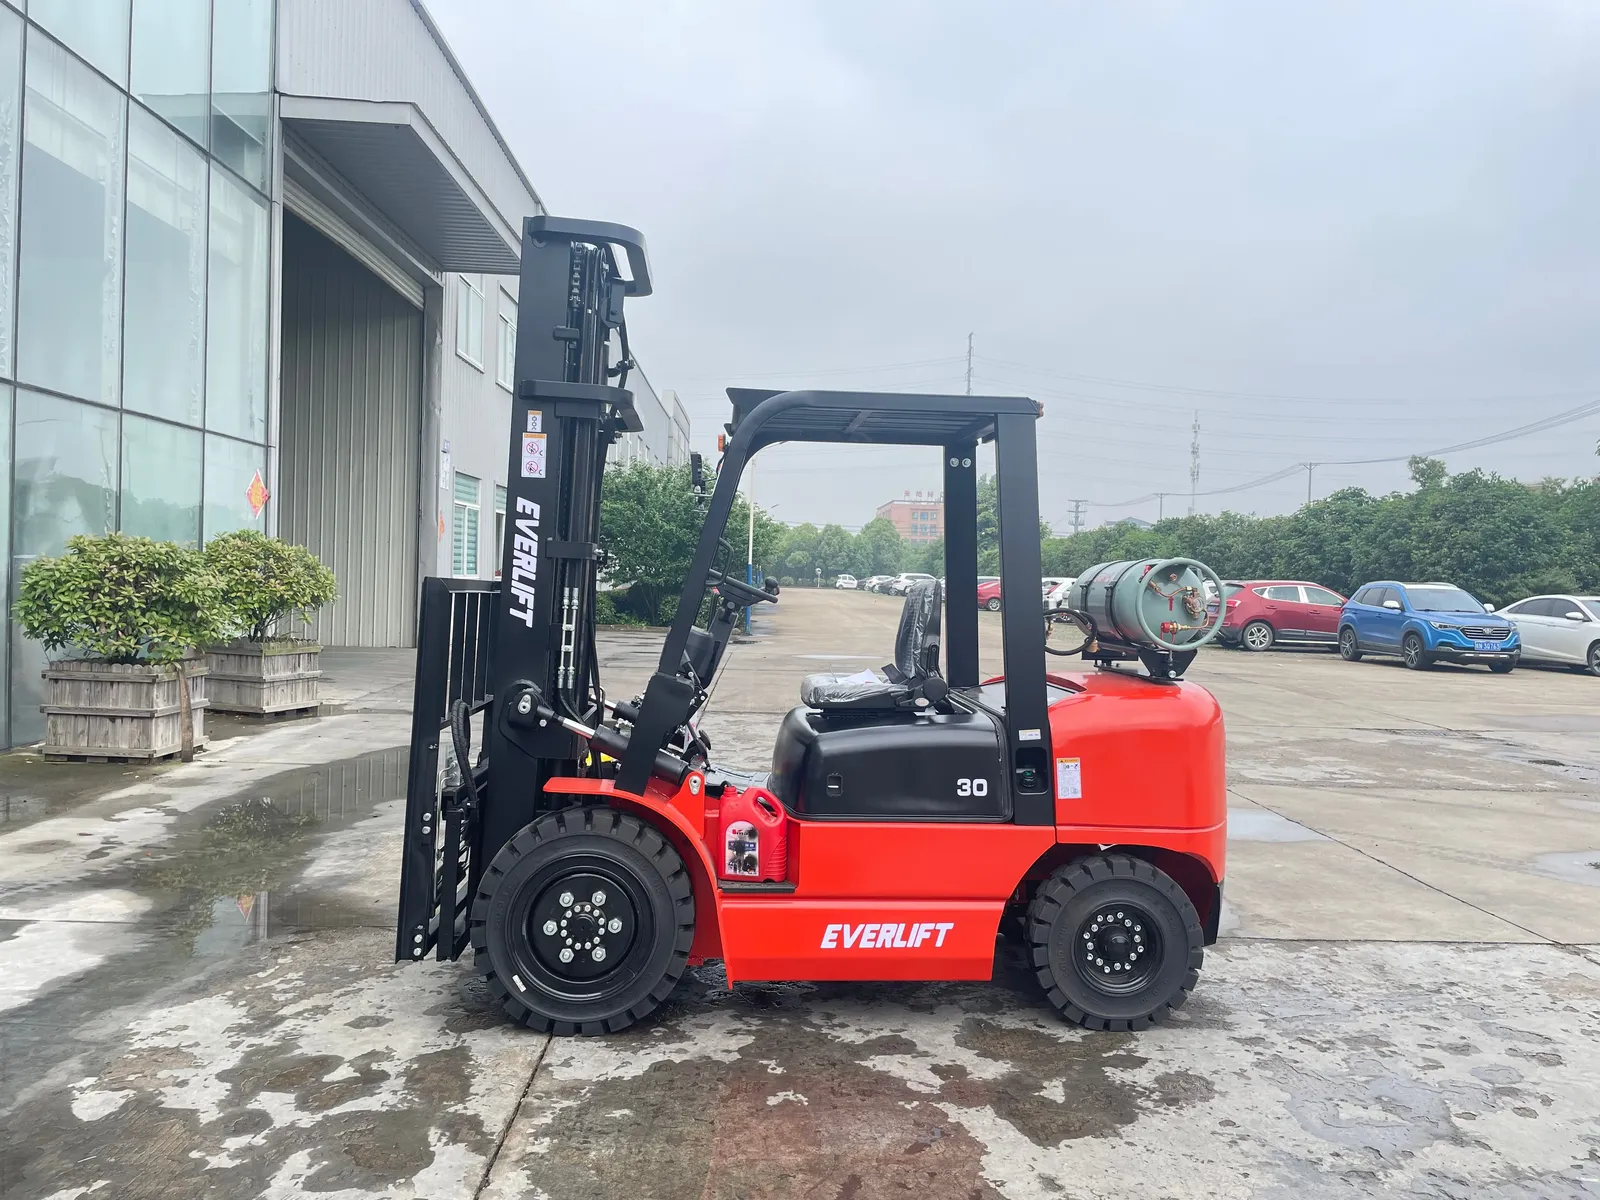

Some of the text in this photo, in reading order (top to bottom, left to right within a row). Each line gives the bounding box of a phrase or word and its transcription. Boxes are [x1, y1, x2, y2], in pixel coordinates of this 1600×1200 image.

[510, 496, 541, 629] EVERLIFT
[956, 778, 988, 797] 30
[820, 922, 954, 949] EVERLIFT
